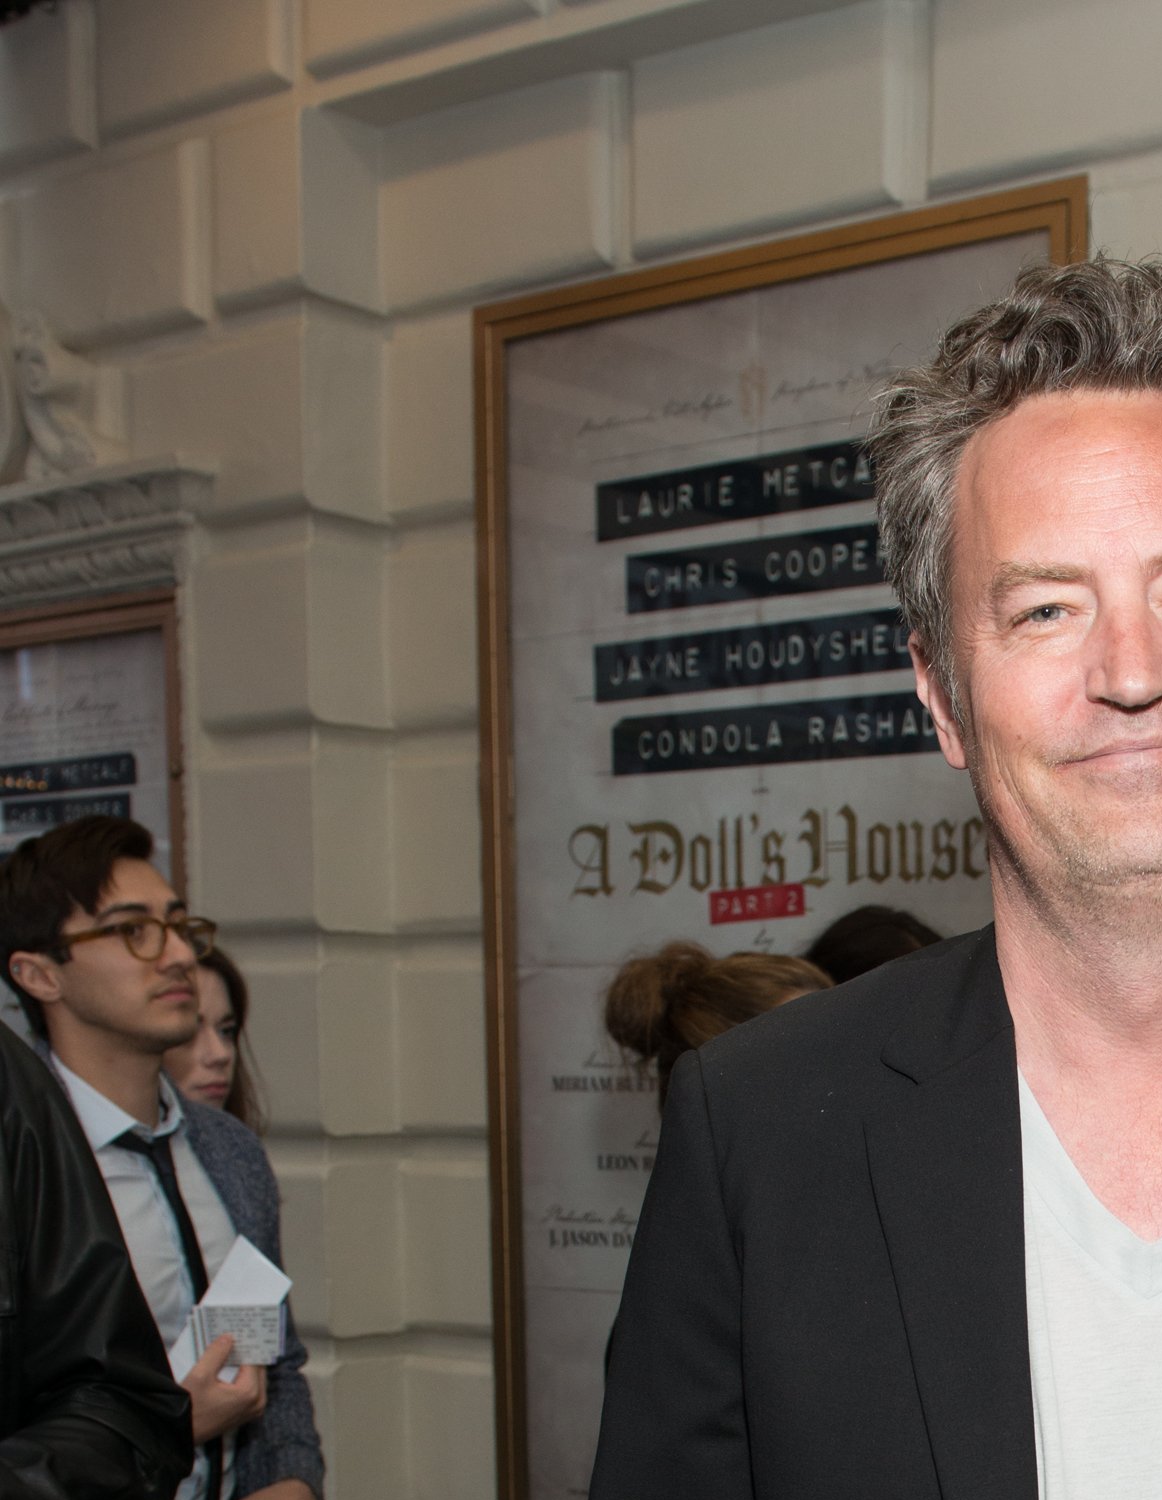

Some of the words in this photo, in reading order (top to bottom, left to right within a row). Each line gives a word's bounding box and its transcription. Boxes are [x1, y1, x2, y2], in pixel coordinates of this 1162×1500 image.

[616, 474, 736, 526] LAURIE
[643, 556, 739, 599] CHRIS
[609, 647, 701, 686] JAYNE
[637, 719, 783, 760] CONDOLA
[567, 822, 616, 899] A
[626, 810, 787, 896] Doll's
[716, 890, 775, 917] PART
[785, 889, 801, 914] 2
[597, 1154, 640, 1171] LEON
[562, 1229, 610, 1248] JASON
